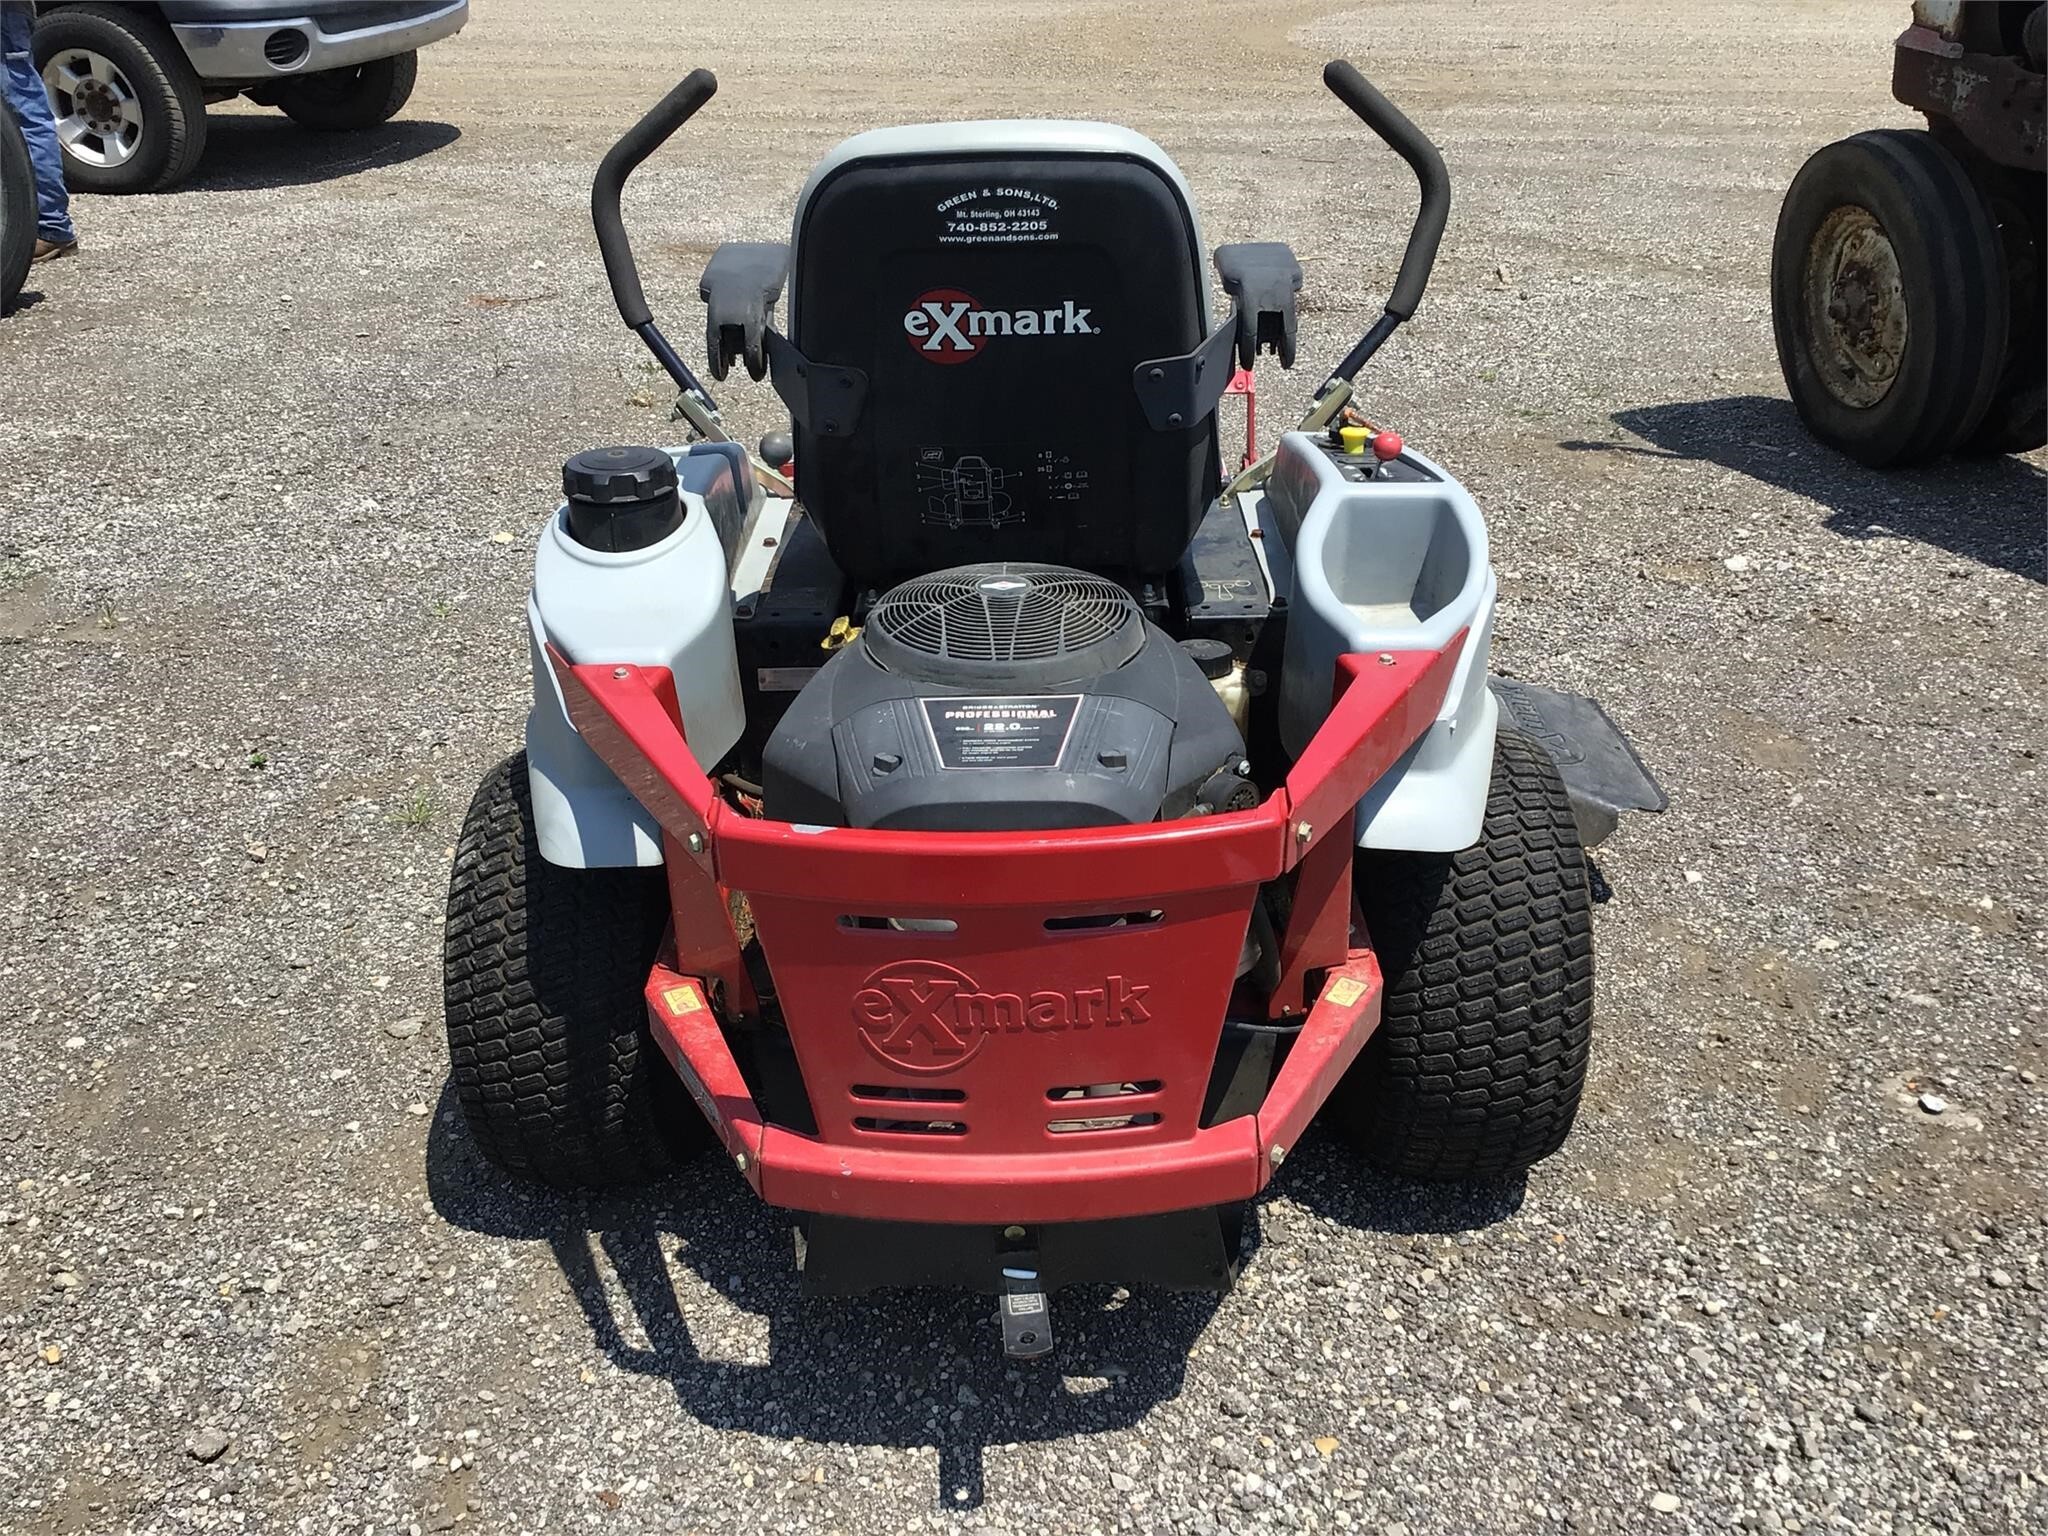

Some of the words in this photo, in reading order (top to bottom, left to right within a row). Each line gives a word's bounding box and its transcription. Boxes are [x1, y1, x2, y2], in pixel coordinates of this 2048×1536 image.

[937, 190, 977, 212] GREEN
[982, 188, 991, 197] &
[956, 210, 968, 218] Mt.
[970, 209, 1002, 219] Sterling,
[1003, 209, 1015, 217] OH
[1017, 209, 1040, 217] 43143
[947, 221, 1048, 232] 740-852-2205
[938, 233, 1059, 244] www.greenandsons.com
[904, 300, 1092, 350] eXmark
[944, 709, 1057, 719] PROFESSIONAL
[852, 975, 1151, 1056] eXmark
